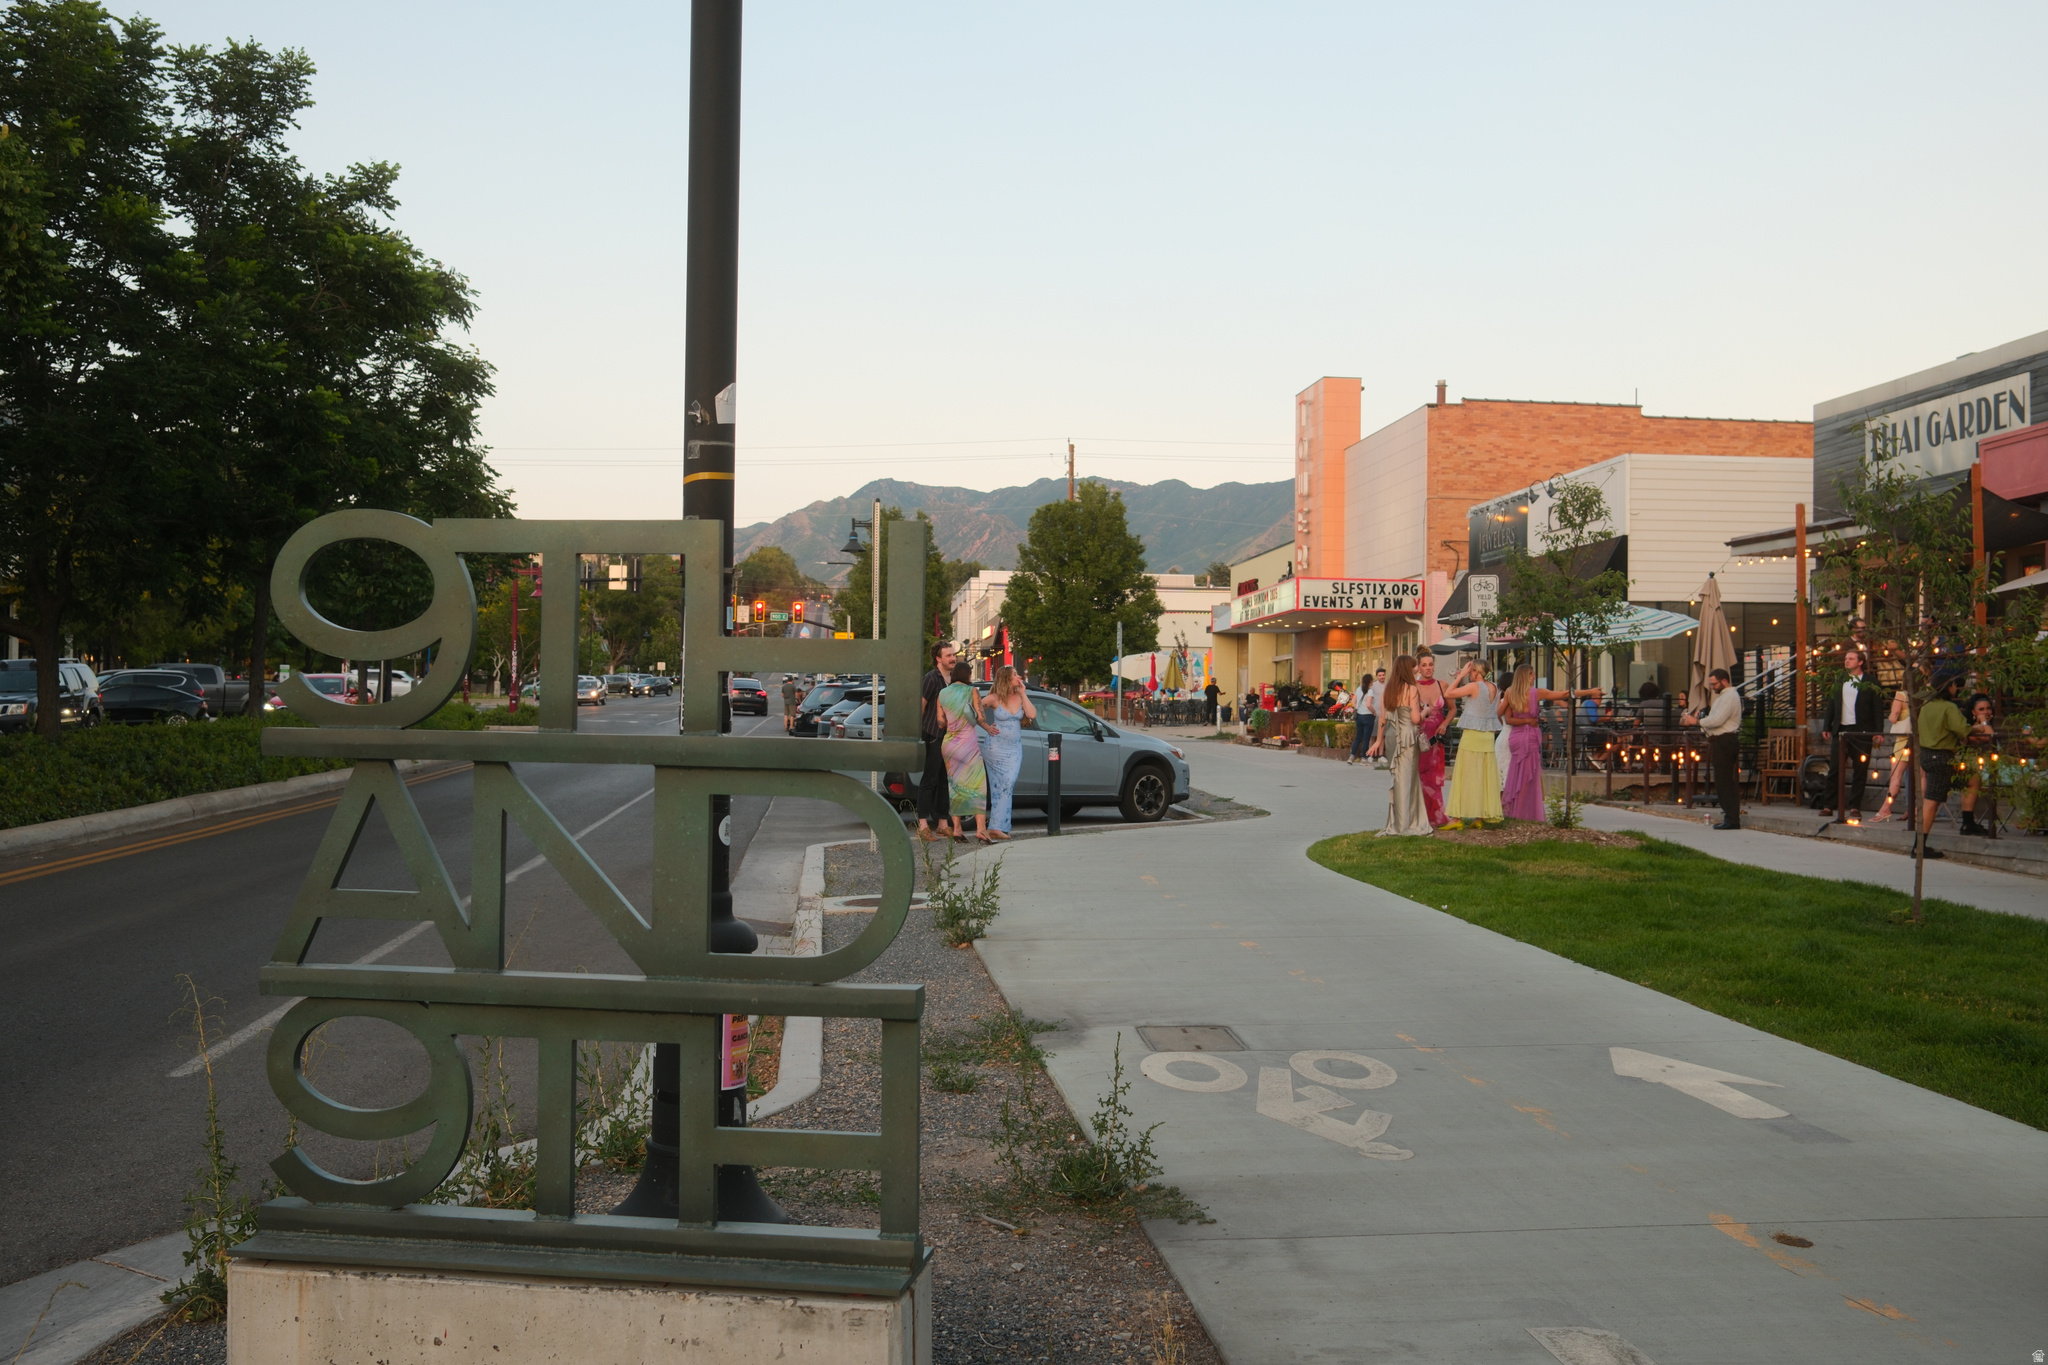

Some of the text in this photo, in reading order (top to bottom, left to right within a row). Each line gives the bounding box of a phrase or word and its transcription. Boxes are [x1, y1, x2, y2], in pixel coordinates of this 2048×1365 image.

[1298, 400, 1311, 570] TOWER
[1871, 385, 2026, 463] THAI GARDEN
[1332, 582, 1419, 596] SLFSTIX.ORG
[1479, 525, 1516, 553] JEWELERS
[270, 508, 924, 738] 9TH
[1304, 596, 1421, 610] EVENTS AT BW Y
[267, 760, 914, 986] AND
[266, 996, 920, 1238] 9TH
